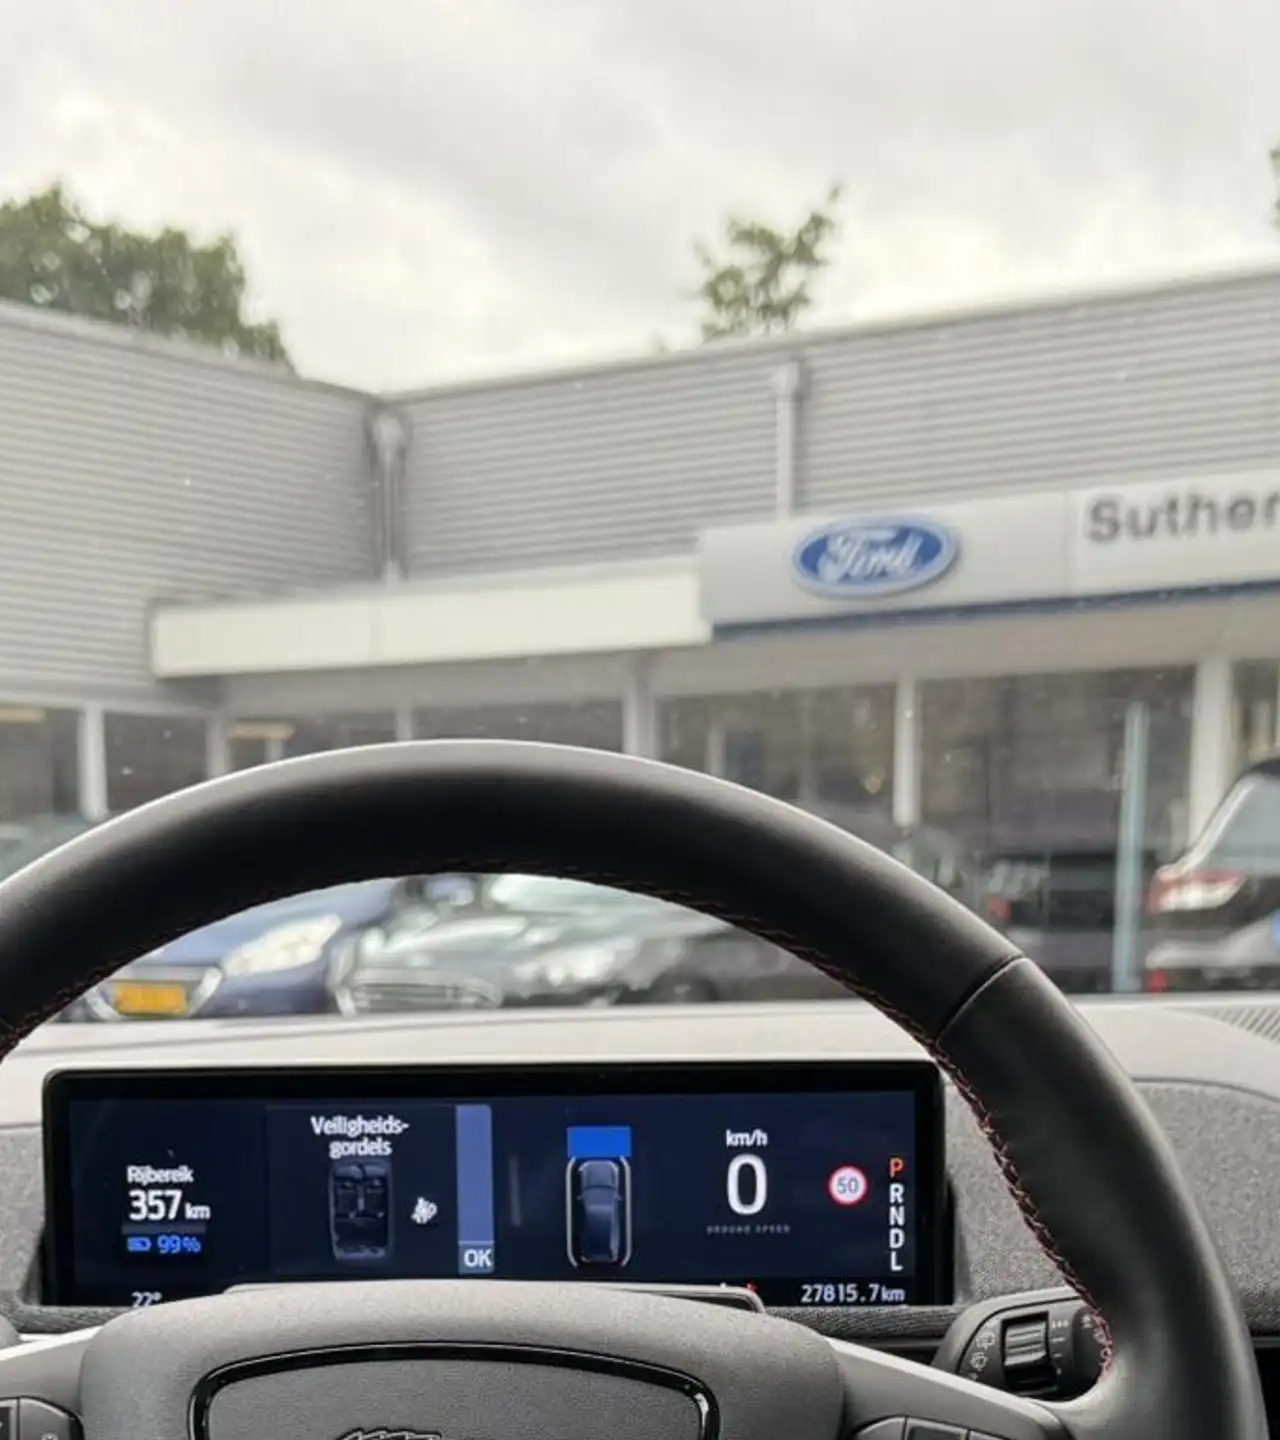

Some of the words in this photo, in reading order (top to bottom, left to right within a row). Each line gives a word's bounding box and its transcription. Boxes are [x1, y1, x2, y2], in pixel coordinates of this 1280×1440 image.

[817, 528, 926, 584] Ford
[310, 1115, 410, 1138] Veiligheids-
[328, 1137, 393, 1160] gordels
[725, 1128, 769, 1148] km/h
[126, 1164, 195, 1186] Rijbereik
[888, 1156, 905, 1178] P
[726, 1153, 769, 1216] 0
[837, 1176, 860, 1195] 50
[889, 1182, 905, 1204] R
[128, 1189, 183, 1220] 357
[184, 1203, 212, 1220] km
[889, 1205, 905, 1226] N
[157, 1235, 202, 1254] 99%
[889, 1227, 905, 1249] D
[463, 1248, 493, 1269] OK
[889, 1250, 904, 1272] L
[800, 1283, 880, 1304] 27815.7
[881, 1285, 906, 1303] km
